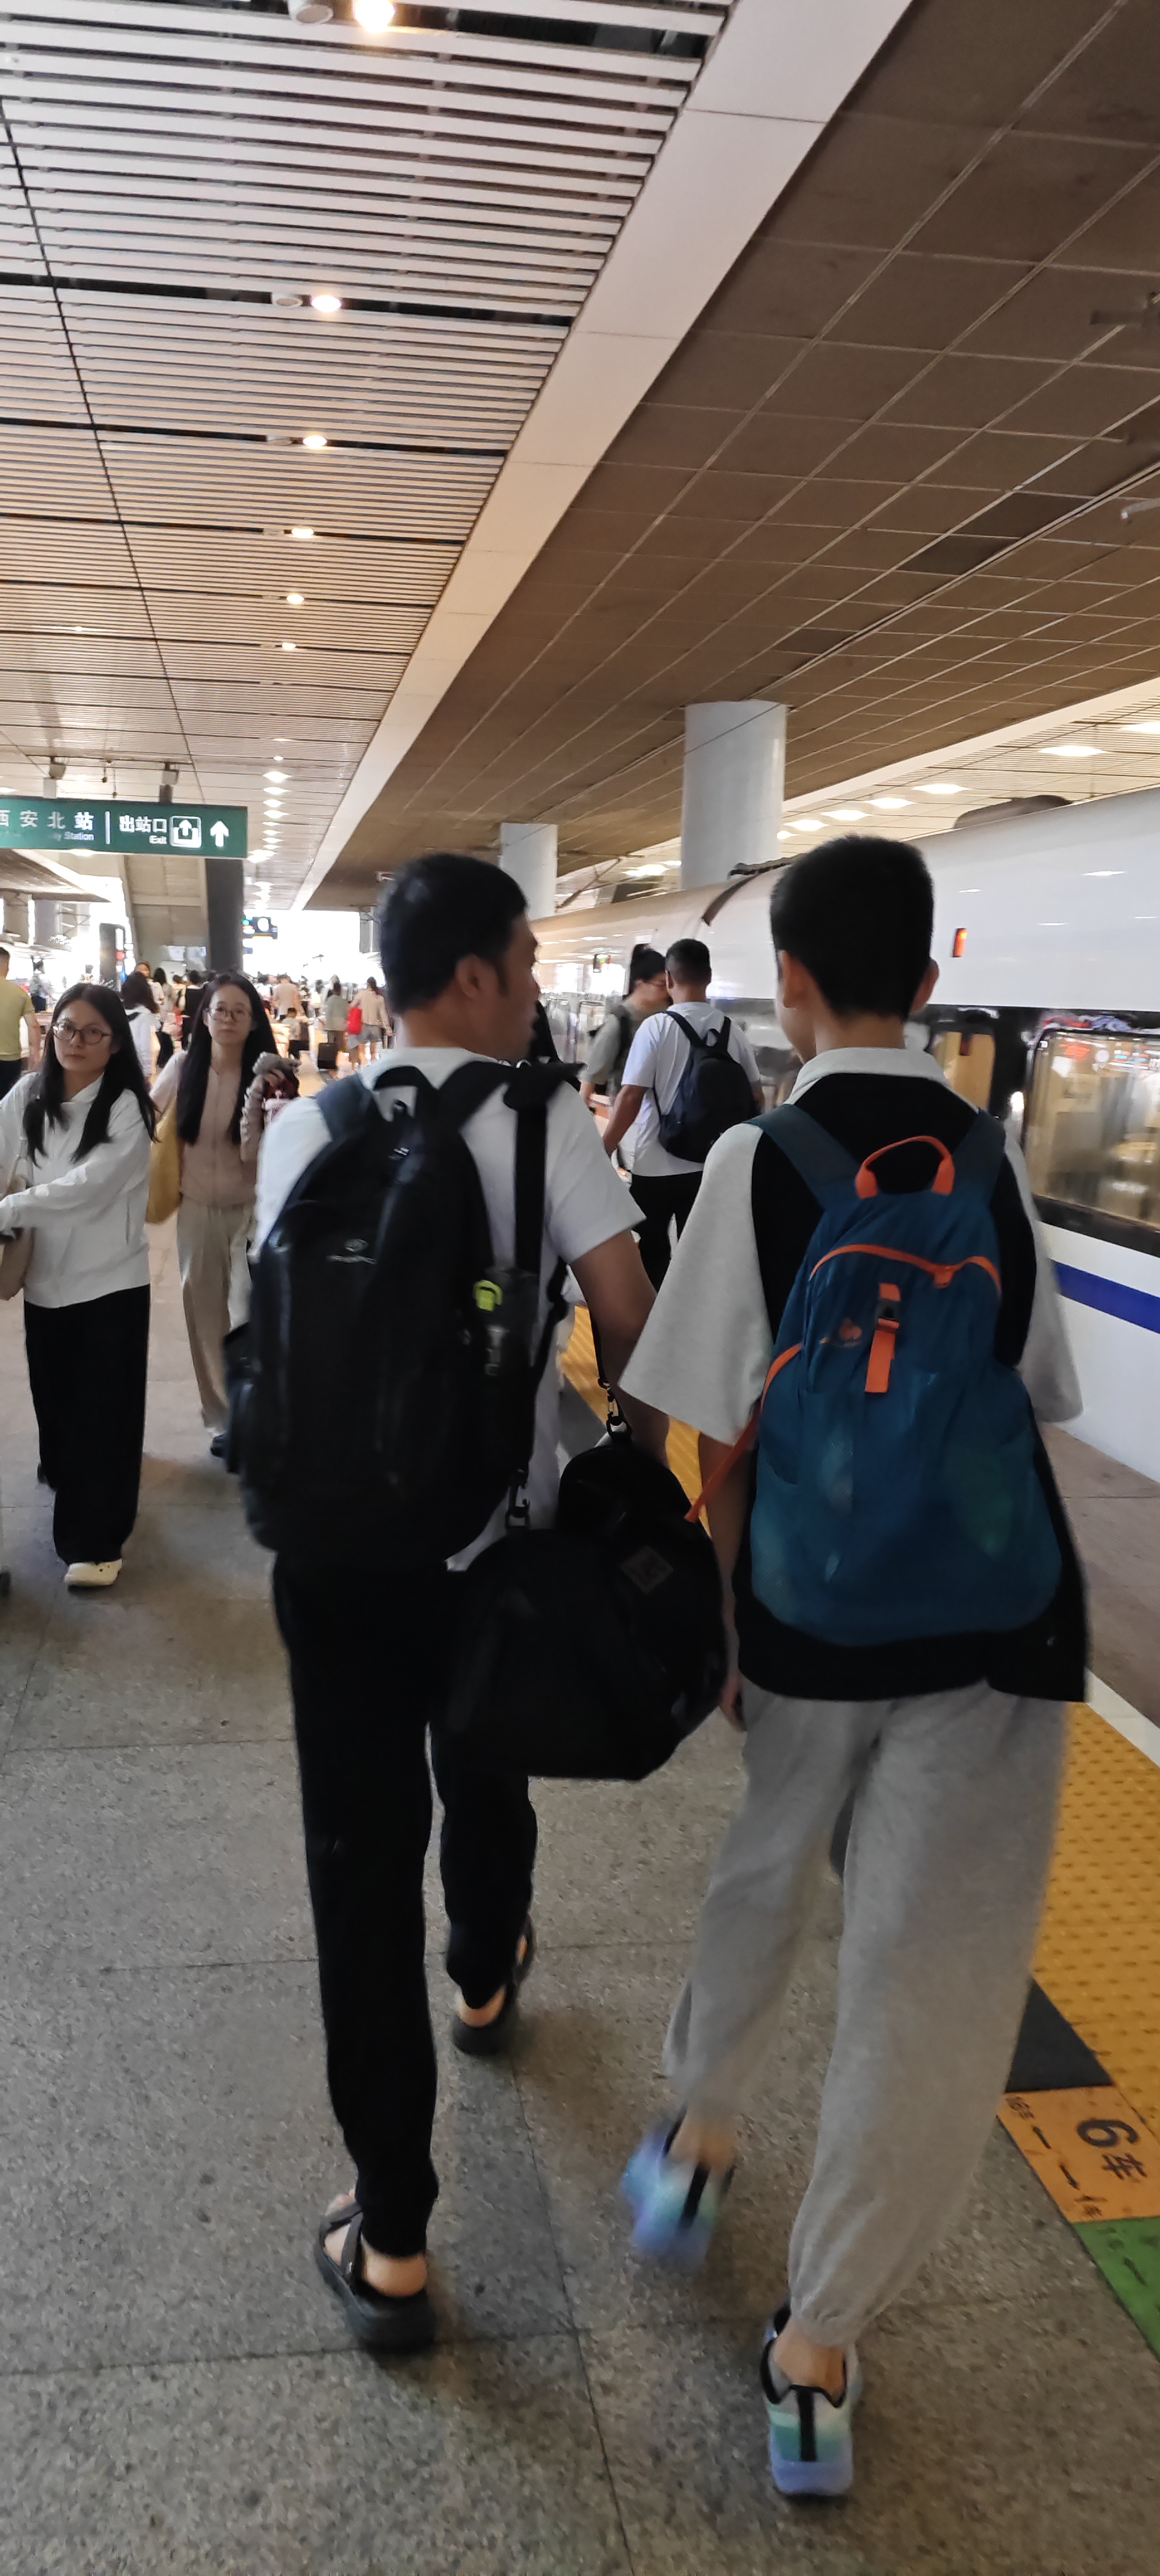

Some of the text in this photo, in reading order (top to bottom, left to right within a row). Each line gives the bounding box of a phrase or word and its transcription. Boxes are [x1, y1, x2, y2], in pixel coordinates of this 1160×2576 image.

[0, 809, 94, 830] 西安北站
[119, 815, 167, 833] 出站口
[64, 831, 94, 841] Station
[148, 835, 167, 844] Exit
[1076, 2117, 1147, 2180] 6车
